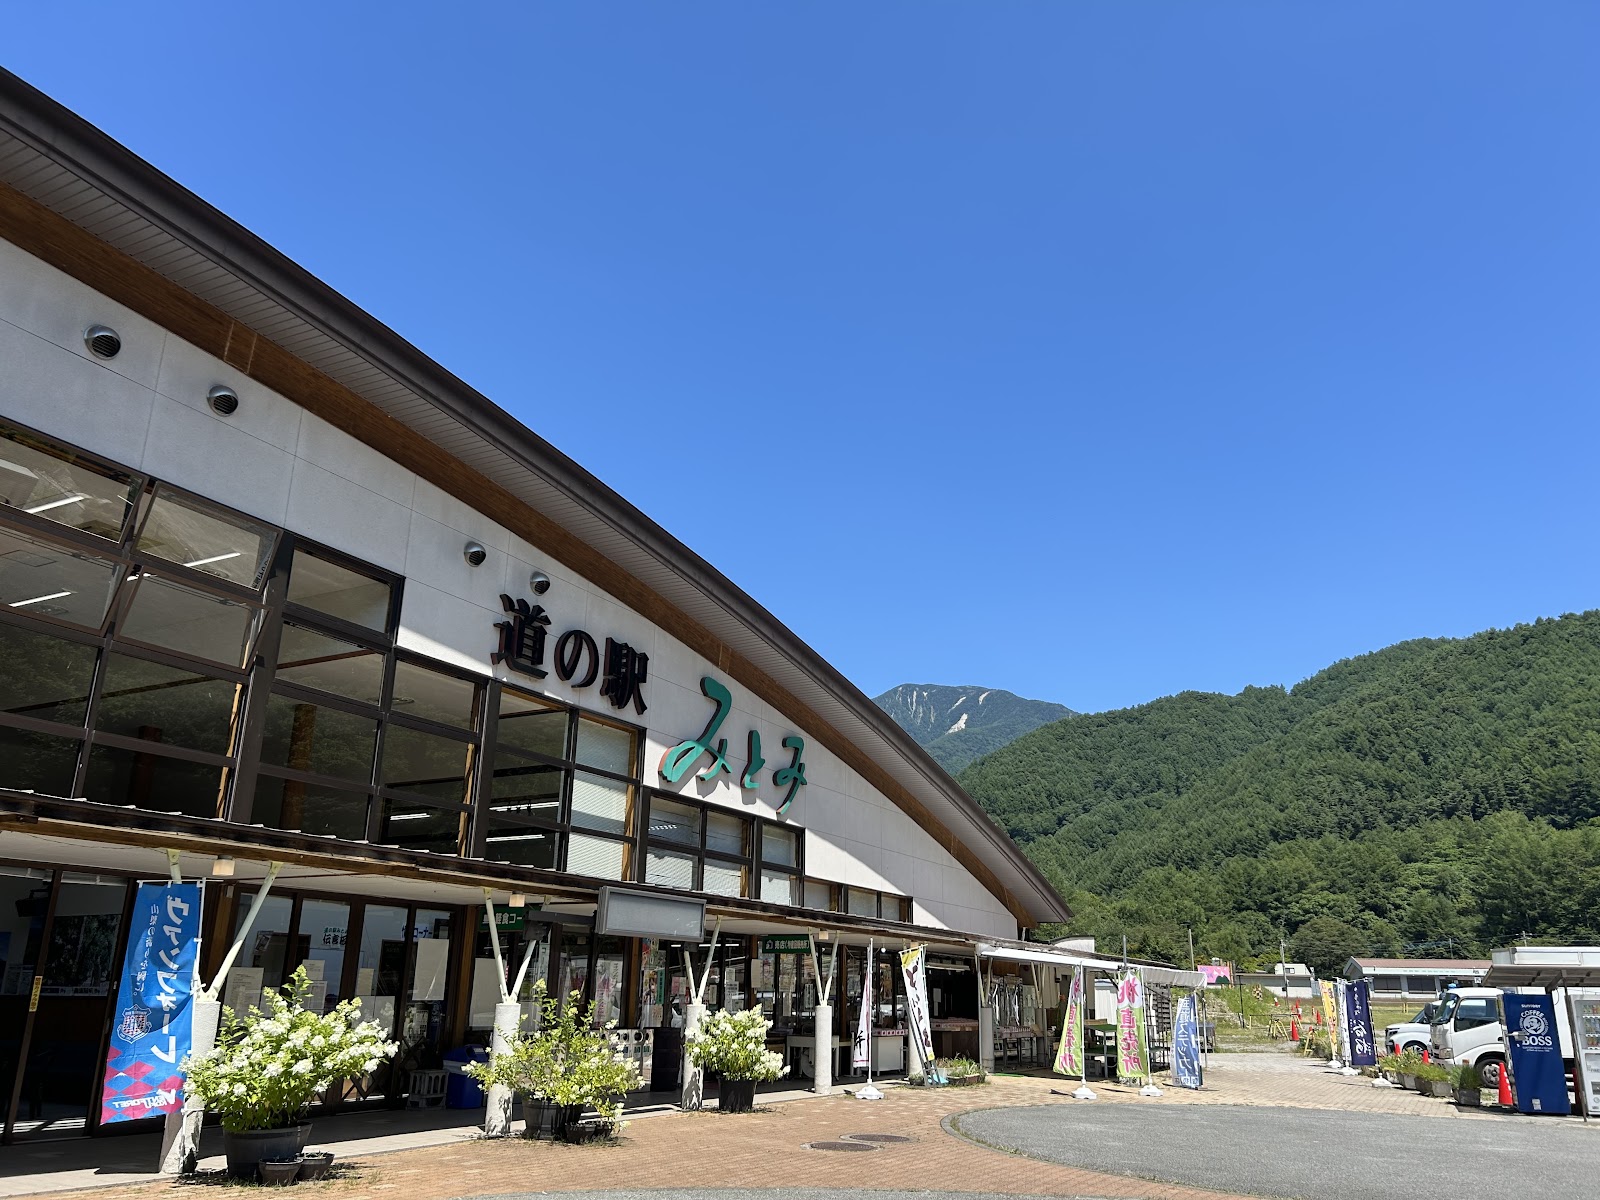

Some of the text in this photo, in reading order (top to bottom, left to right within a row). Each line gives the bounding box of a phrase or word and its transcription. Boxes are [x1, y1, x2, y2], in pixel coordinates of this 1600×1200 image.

[490, 593, 807, 816] 道の駅 みとみ
[1520, 1010, 1545, 1018] COFFEE
[1522, 1035, 1552, 1046] BOSS
